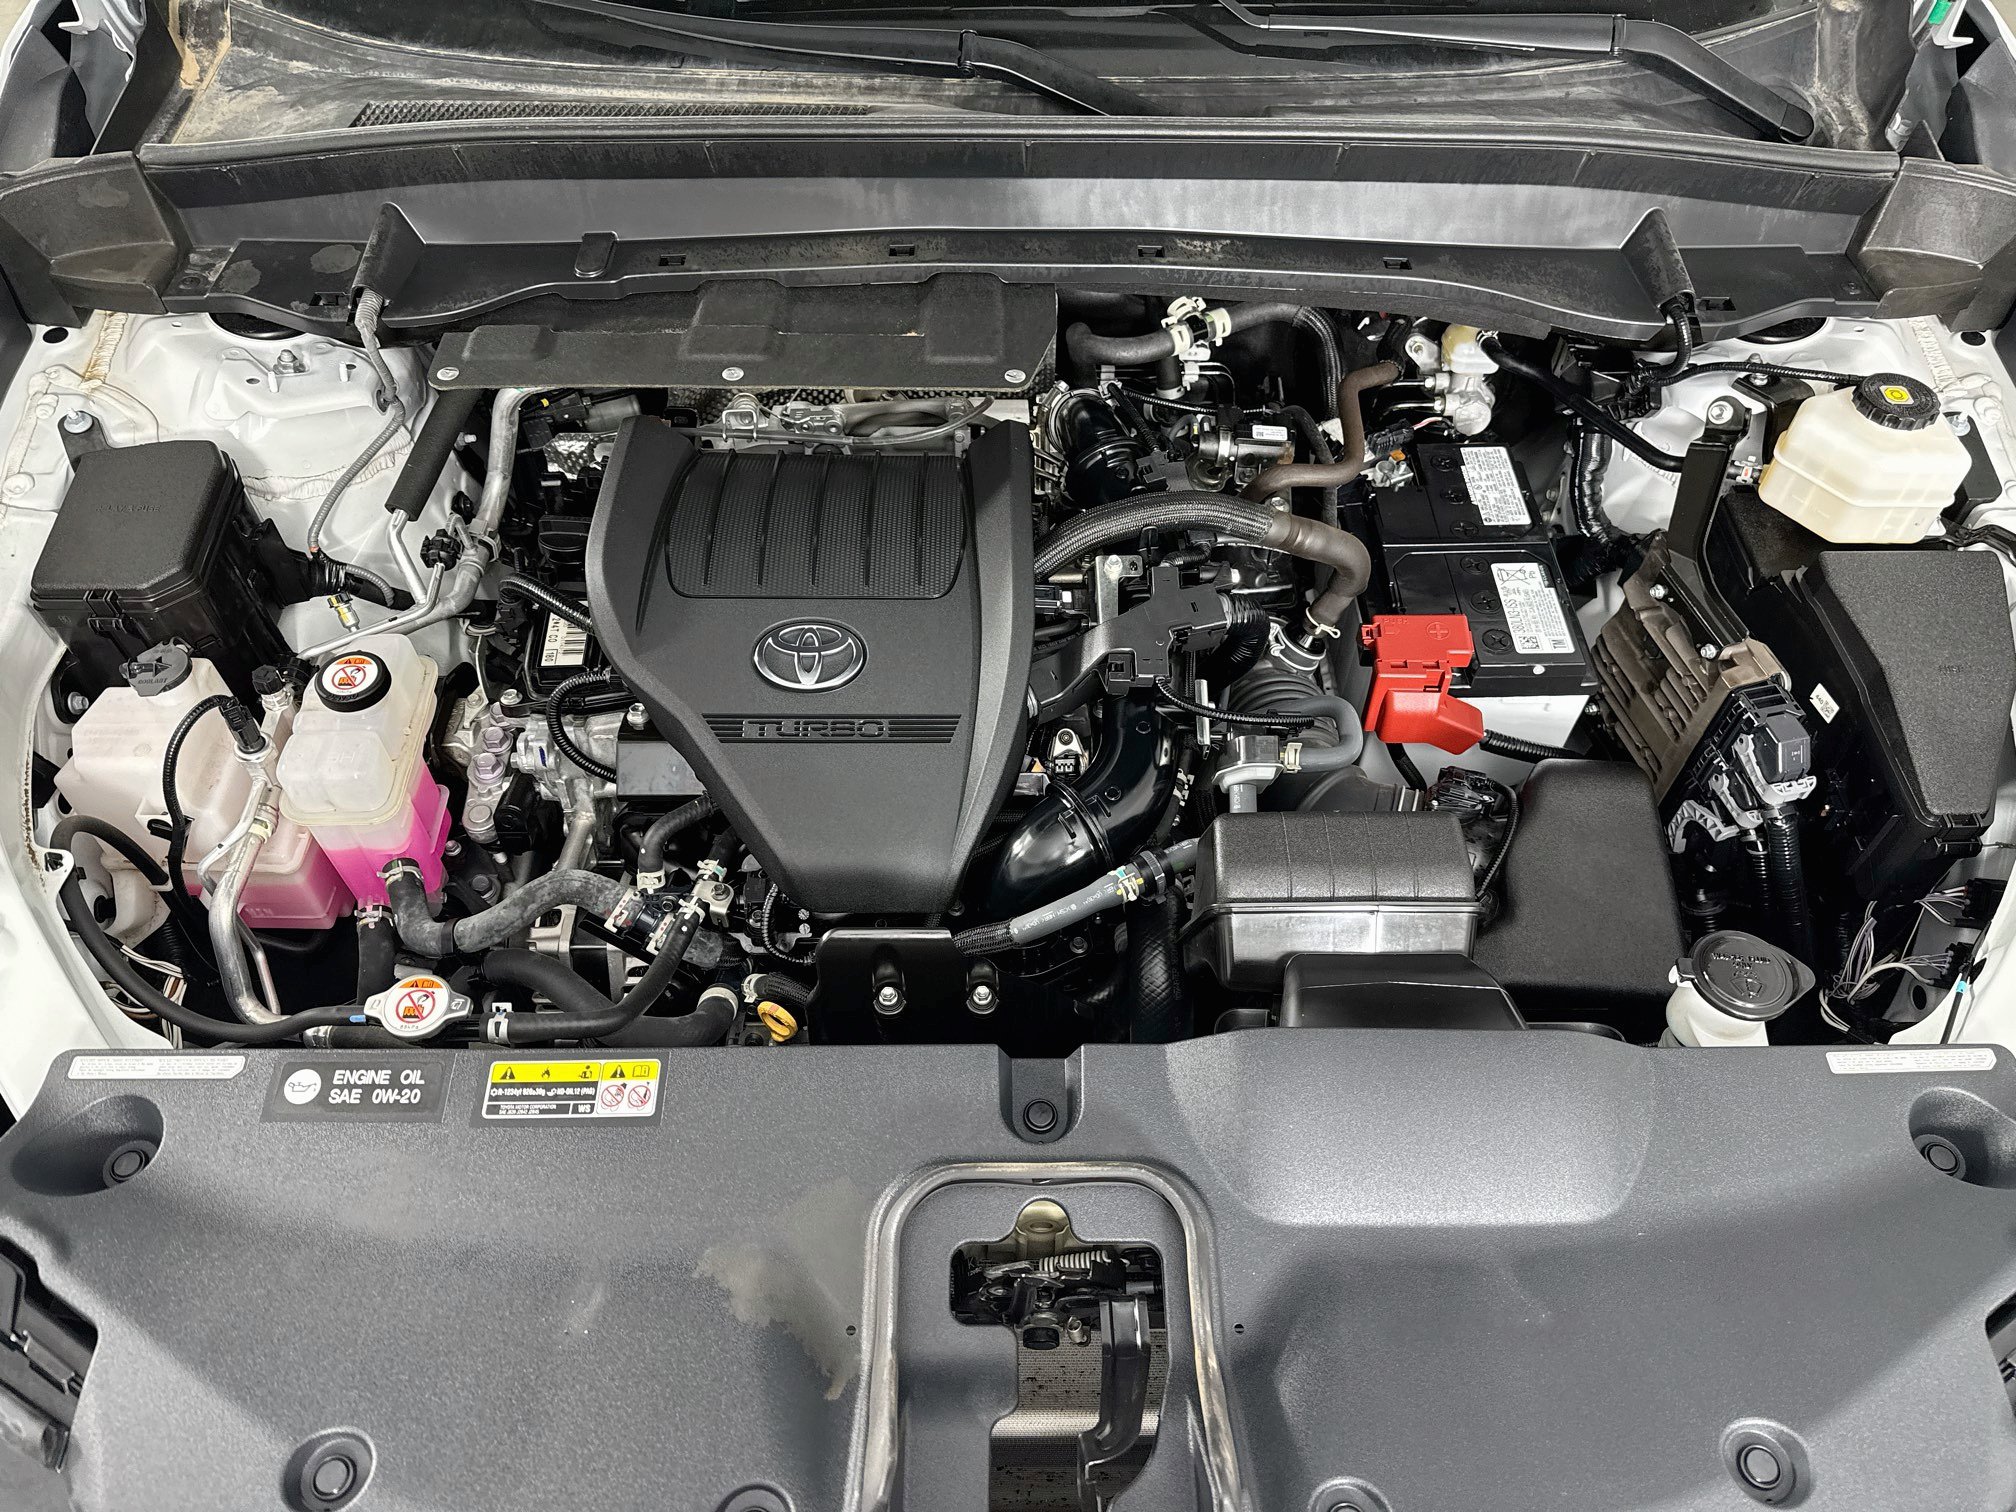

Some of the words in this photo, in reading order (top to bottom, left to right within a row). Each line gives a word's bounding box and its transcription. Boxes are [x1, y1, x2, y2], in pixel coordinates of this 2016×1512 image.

[747, 720, 884, 737] TURBO
[332, 1070, 392, 1085] ENGINE
[400, 1070, 425, 1085] OIL
[328, 1088, 363, 1104] SAE
[371, 1088, 421, 1104] 0W-20
[578, 1104, 591, 1113] WS
